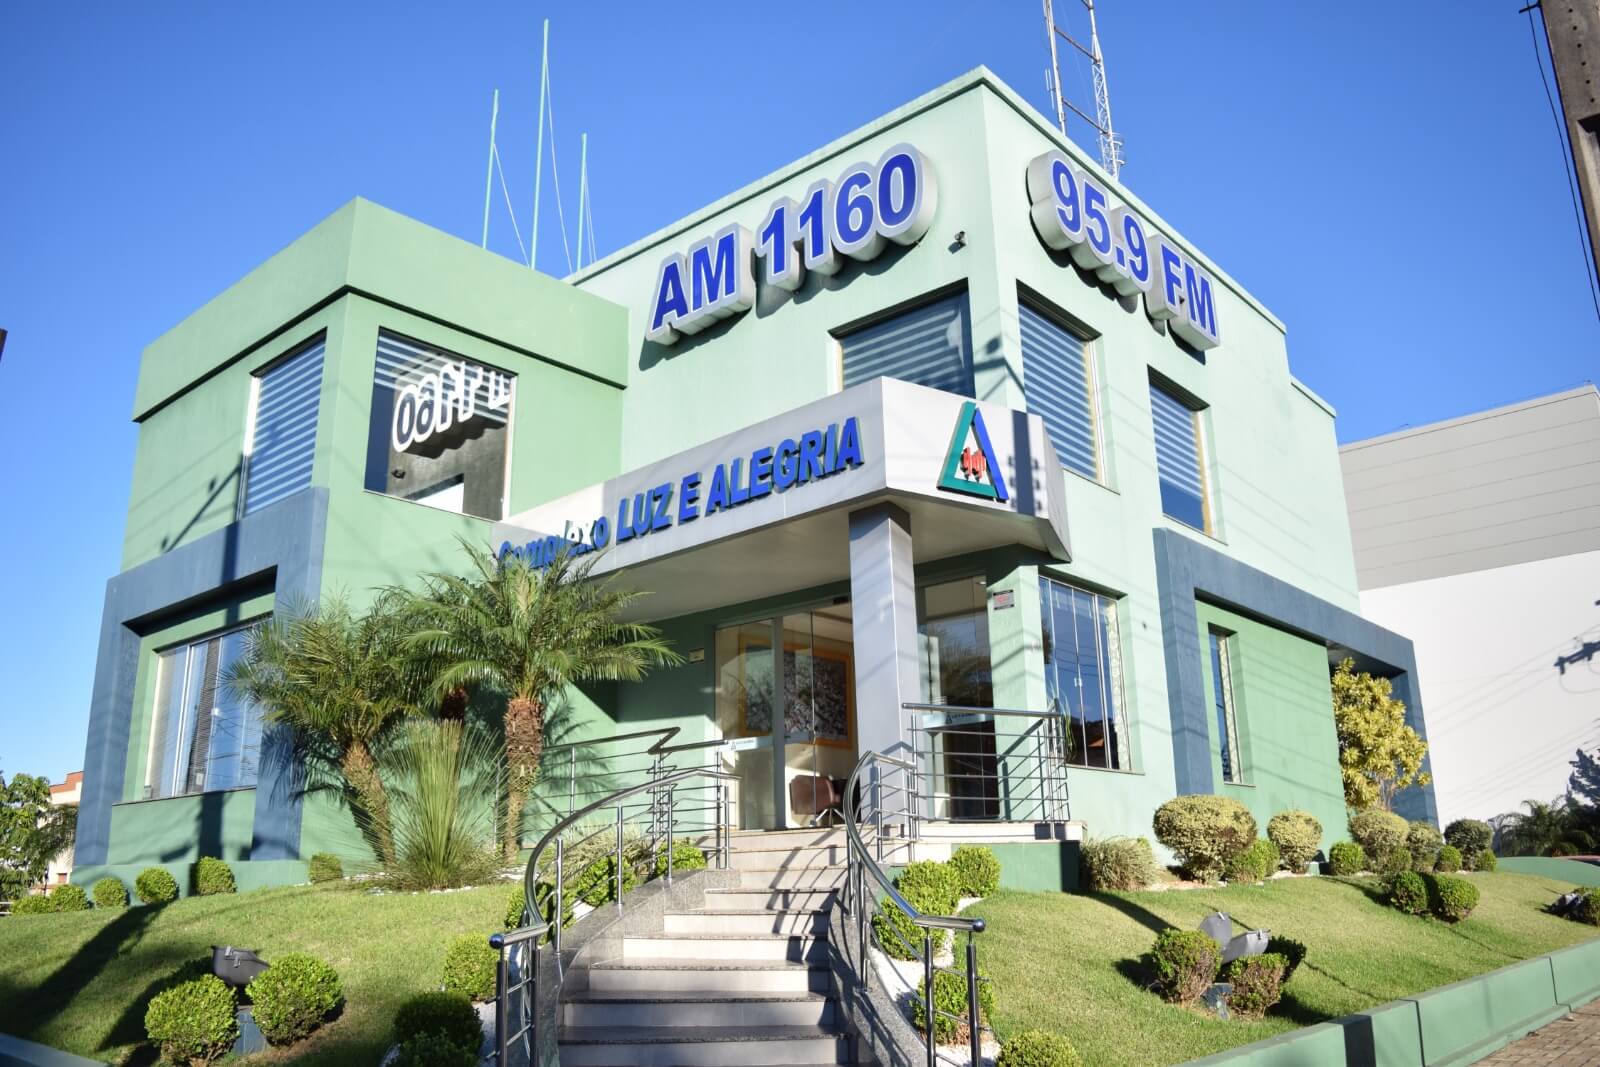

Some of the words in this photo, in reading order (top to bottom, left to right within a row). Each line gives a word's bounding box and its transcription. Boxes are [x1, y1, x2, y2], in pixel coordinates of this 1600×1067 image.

[651, 231, 736, 332] AM
[761, 153, 917, 276] 1160
[1052, 159, 1151, 283] 95.9
[1161, 244, 1217, 337] FM
[616, 482, 673, 545] LUZ
[679, 472, 702, 522] E
[706, 416, 865, 514] ALEGRIA
